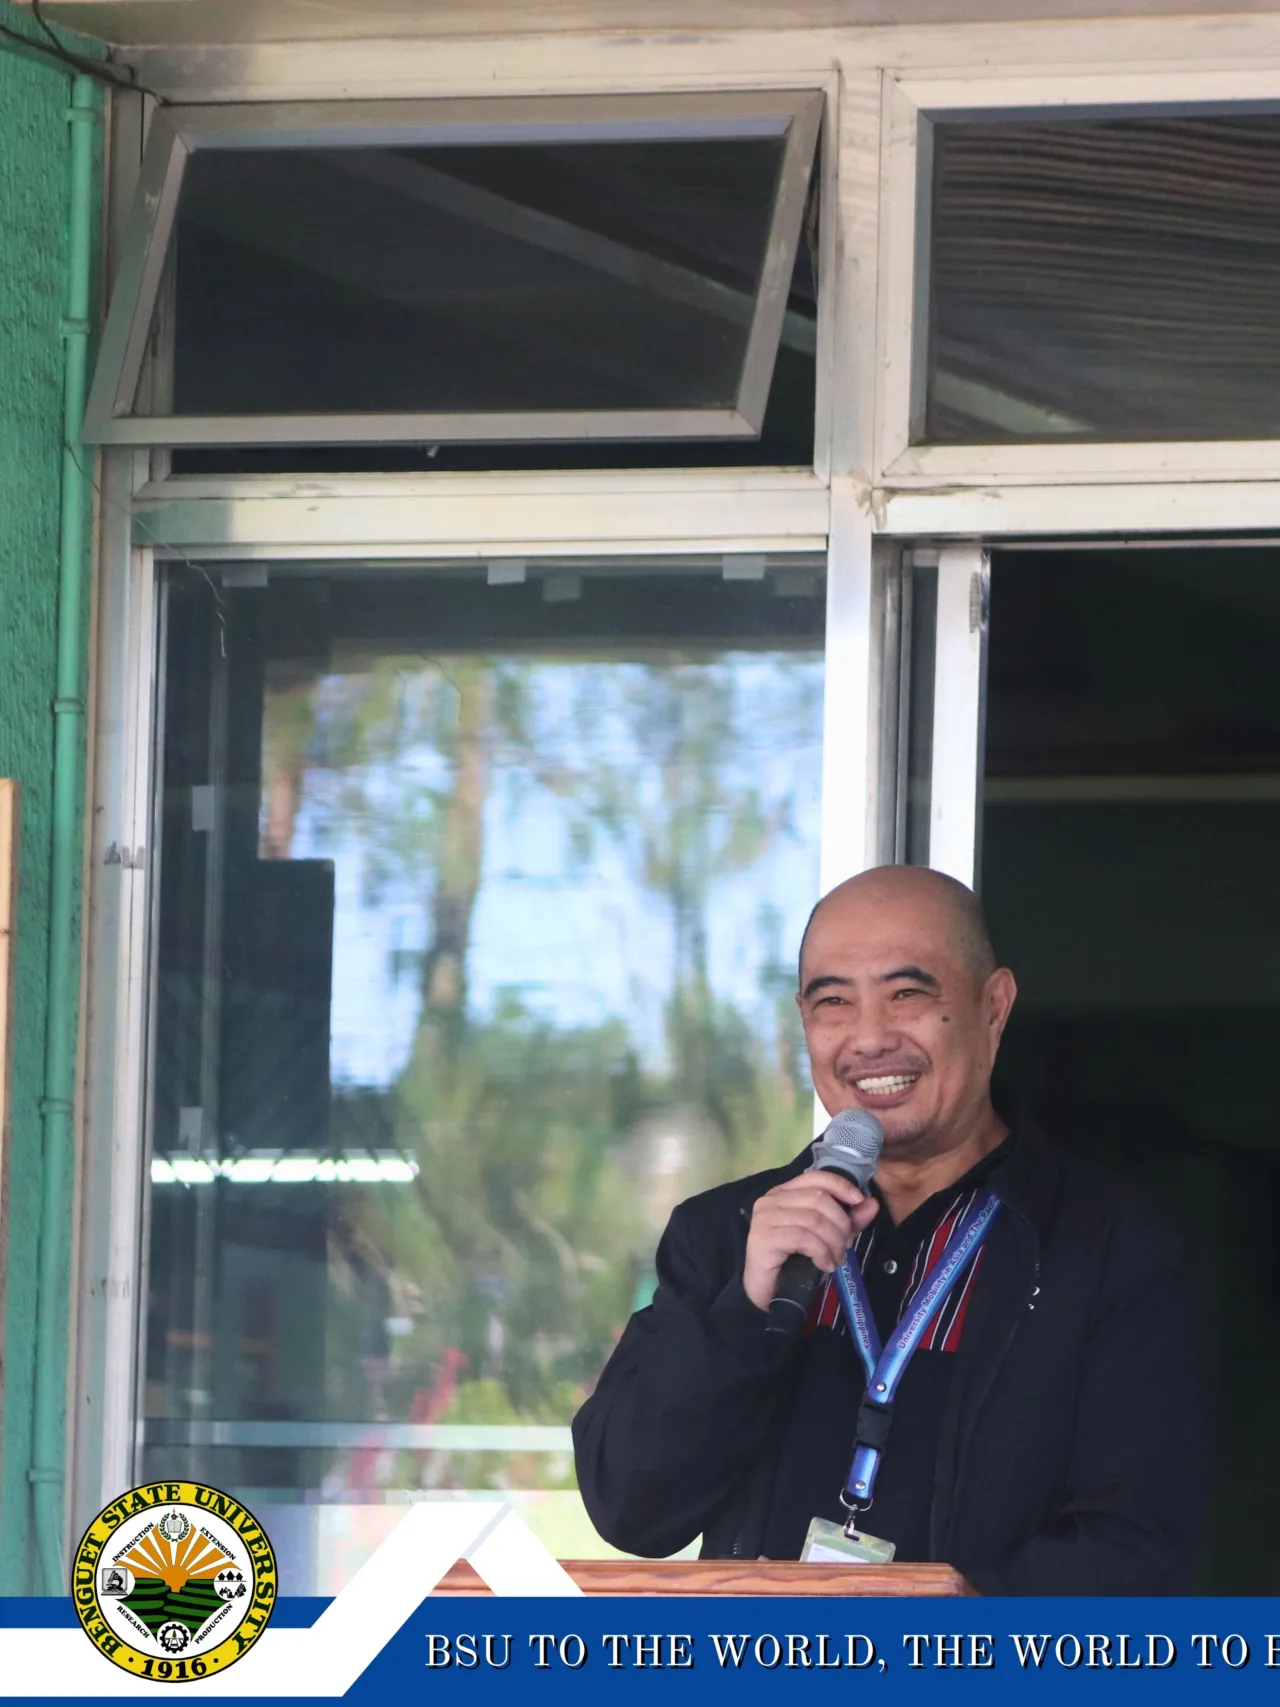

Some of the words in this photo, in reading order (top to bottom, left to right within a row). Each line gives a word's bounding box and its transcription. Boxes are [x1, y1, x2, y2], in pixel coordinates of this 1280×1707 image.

[843, 1267, 857, 1296] Pacific
[853, 1302, 872, 1349] Philippines
[898, 1308, 927, 1349] University
[923, 1276, 947, 1307] Mobility
[950, 1249, 964, 1266] Asia
[961, 1234, 973, 1249] and
[969, 1218, 984, 1233] The
